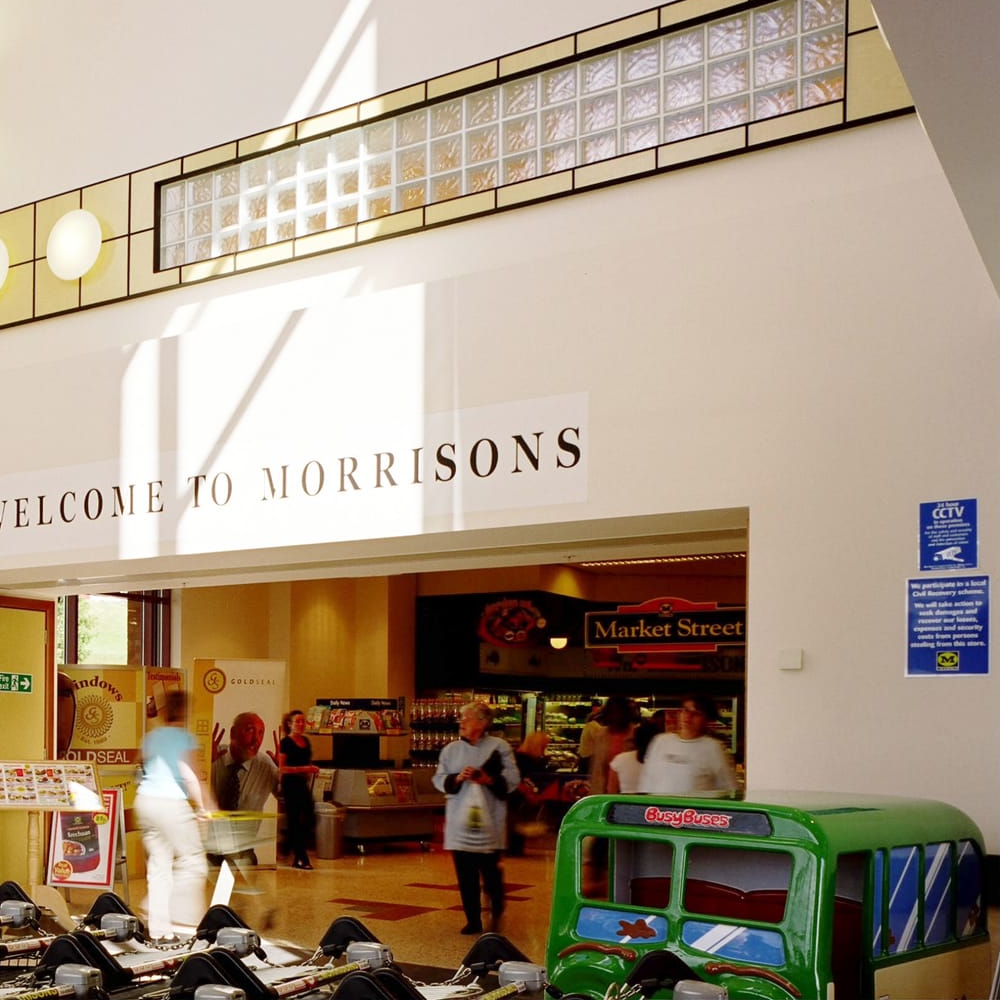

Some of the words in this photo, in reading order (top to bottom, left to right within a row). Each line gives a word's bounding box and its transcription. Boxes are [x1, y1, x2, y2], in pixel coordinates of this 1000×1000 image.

[187, 472, 233, 508] TO
[262, 427, 581, 500] MORRISONS
[932, 506, 964, 519] CCTV
[594, 620, 672, 638] Market
[677, 618, 744, 637] Street
[73, 676, 123, 702] indows
[64, 750, 130, 763] OLDSEAL
